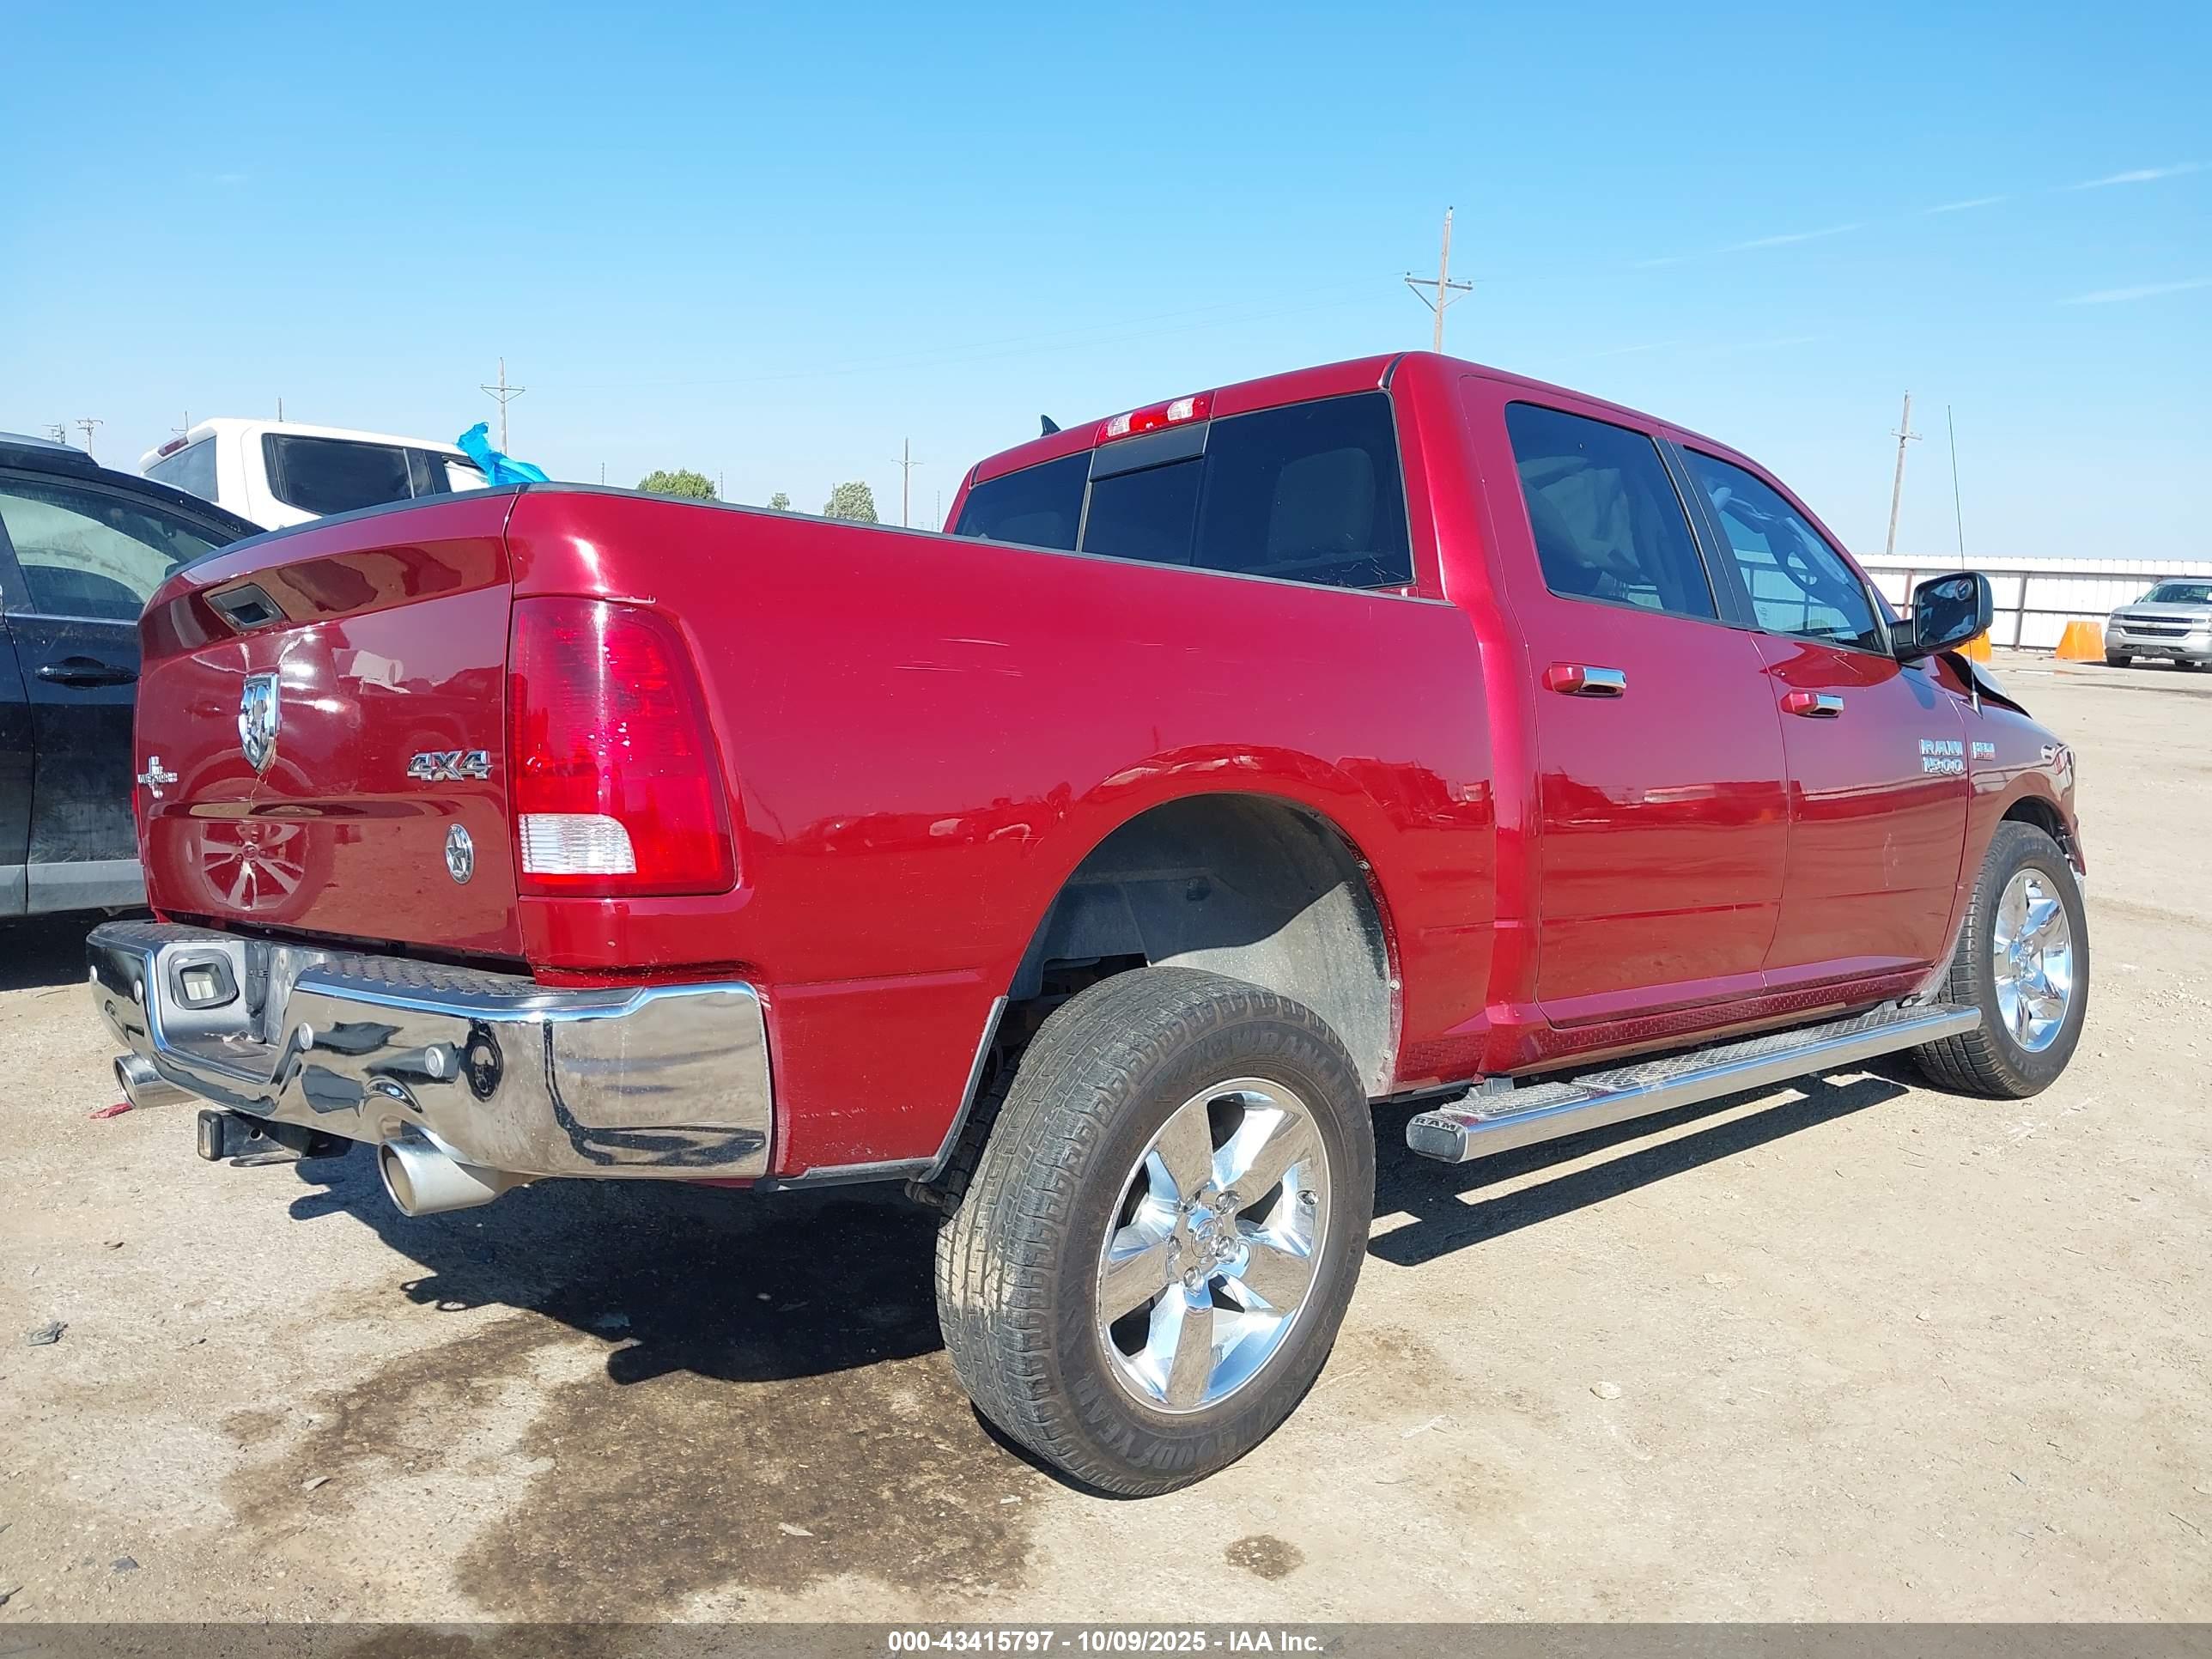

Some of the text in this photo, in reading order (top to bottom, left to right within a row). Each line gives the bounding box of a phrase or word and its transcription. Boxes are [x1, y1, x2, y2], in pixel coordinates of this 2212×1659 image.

[1919, 739, 1963, 756] RAM
[406, 750, 495, 781] 4X4
[1923, 757, 1964, 775] 1500
[1413, 1118, 1457, 1131] RAM
